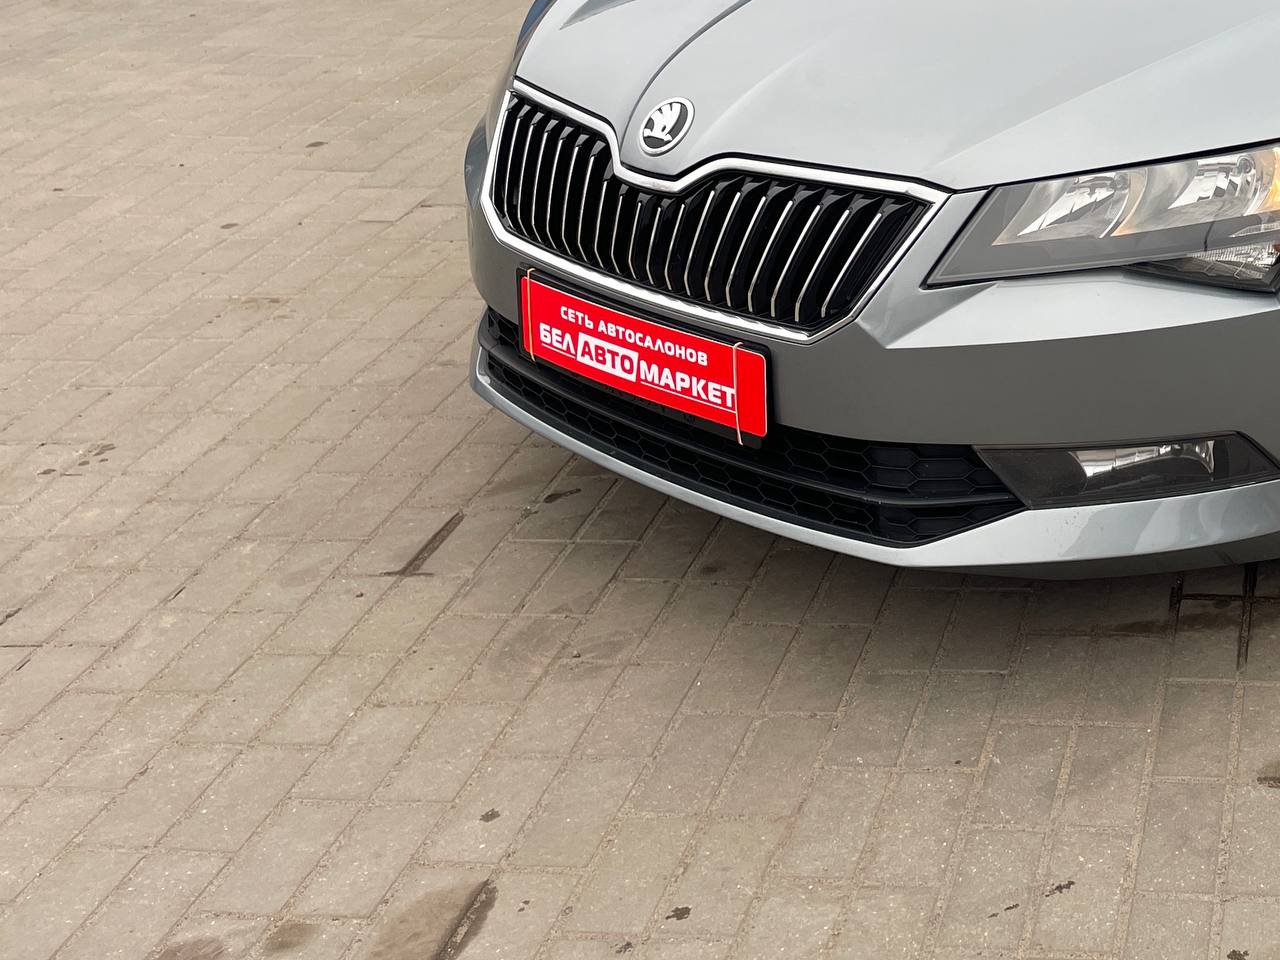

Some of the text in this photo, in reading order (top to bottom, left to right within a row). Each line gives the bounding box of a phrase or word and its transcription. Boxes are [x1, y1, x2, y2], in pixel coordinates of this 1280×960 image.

[539, 322, 736, 408] БЕЛ АВТО МАРКЕТ
[560, 305, 708, 366] СЕТЬ АВТОСАЛОНОВ
